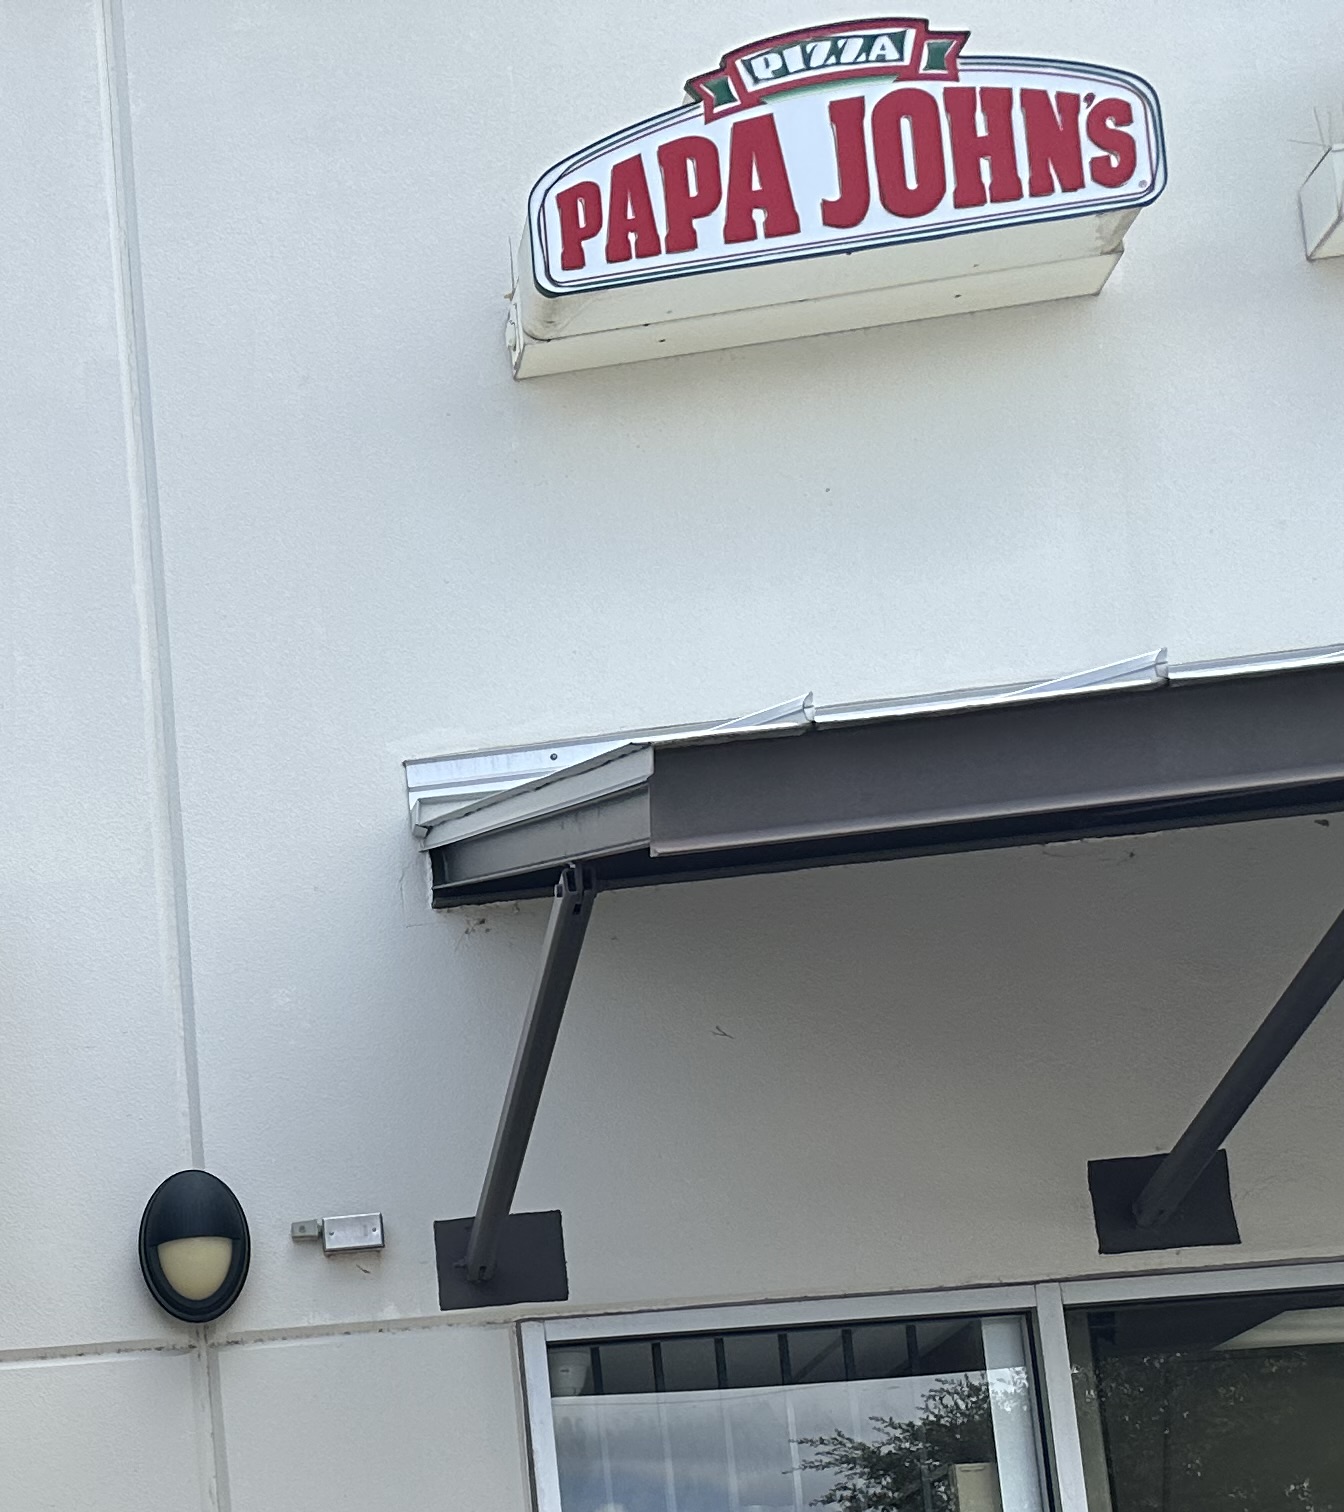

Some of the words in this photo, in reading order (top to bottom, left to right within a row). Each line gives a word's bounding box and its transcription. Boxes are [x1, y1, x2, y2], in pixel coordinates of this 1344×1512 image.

[749, 33, 903, 81] PIZZA
[554, 112, 802, 270] PAPA
[820, 85, 1139, 230] JOHN'S
